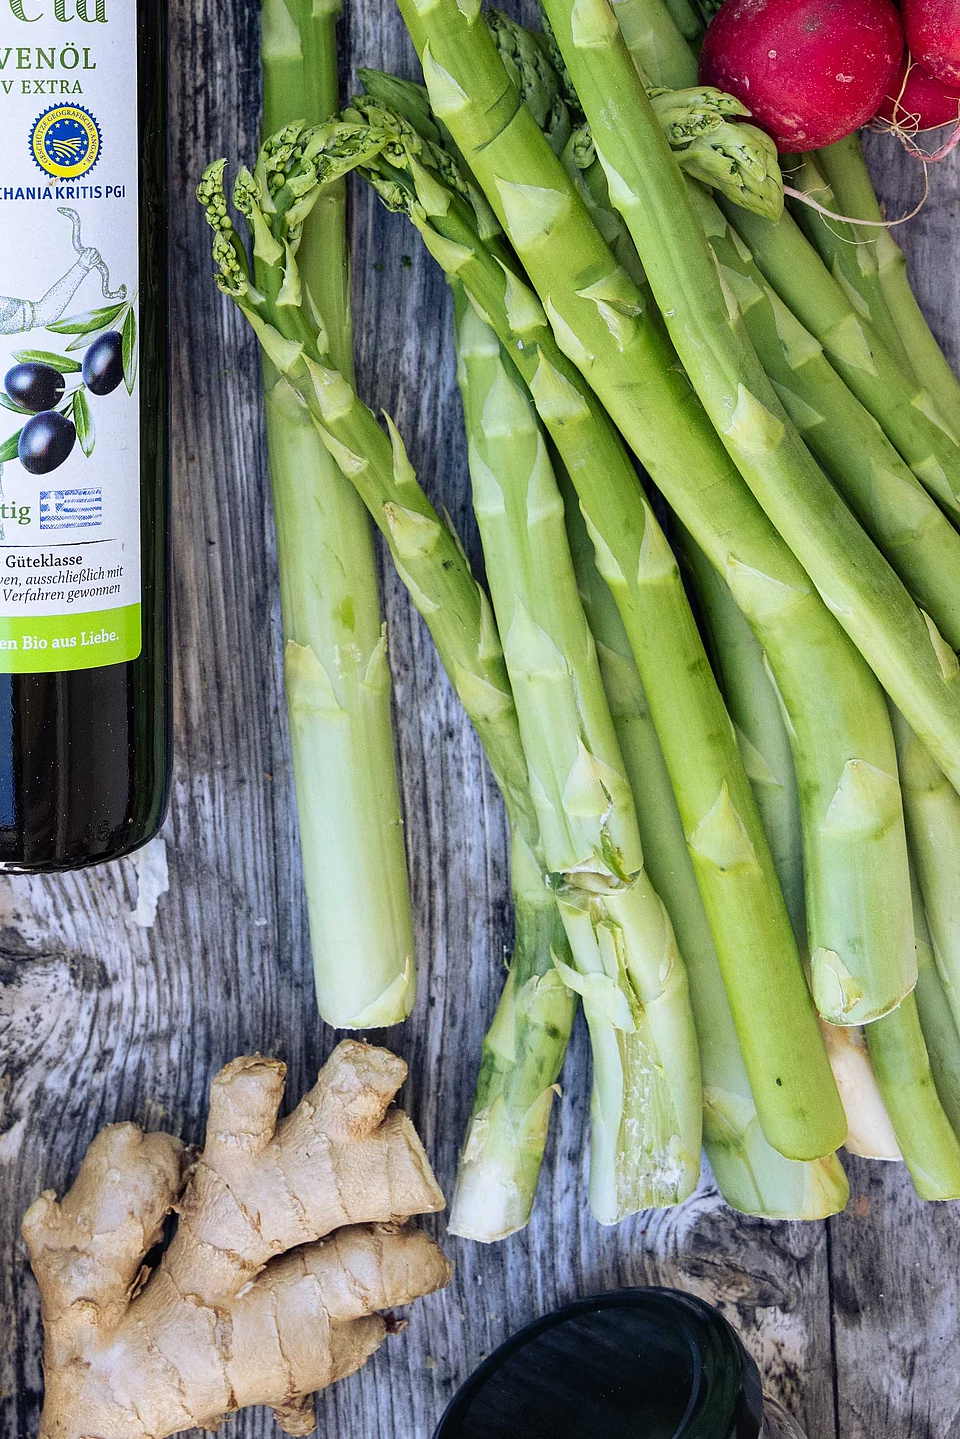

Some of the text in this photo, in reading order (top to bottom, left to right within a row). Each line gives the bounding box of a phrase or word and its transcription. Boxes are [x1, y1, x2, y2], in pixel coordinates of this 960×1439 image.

[21, 79, 83, 94] EXTRA
[47, 110, 94, 132] GEOGRAFISCHE
[86, 134, 97, 163] ANGABE
[56, 186, 102, 200] KRITIS
[105, 185, 126, 199] PGI
[5, 553, 83, 568] Güteklasse
[25, 568, 105, 586] ausschließlich
[106, 565, 124, 578] mit
[3, 587, 64, 604] Verfahren
[66, 583, 121, 603] gewonnen
[22, 631, 48, 649] Bio
[51, 637, 77, 648] aus
[80, 628, 119, 646] Liebe.
